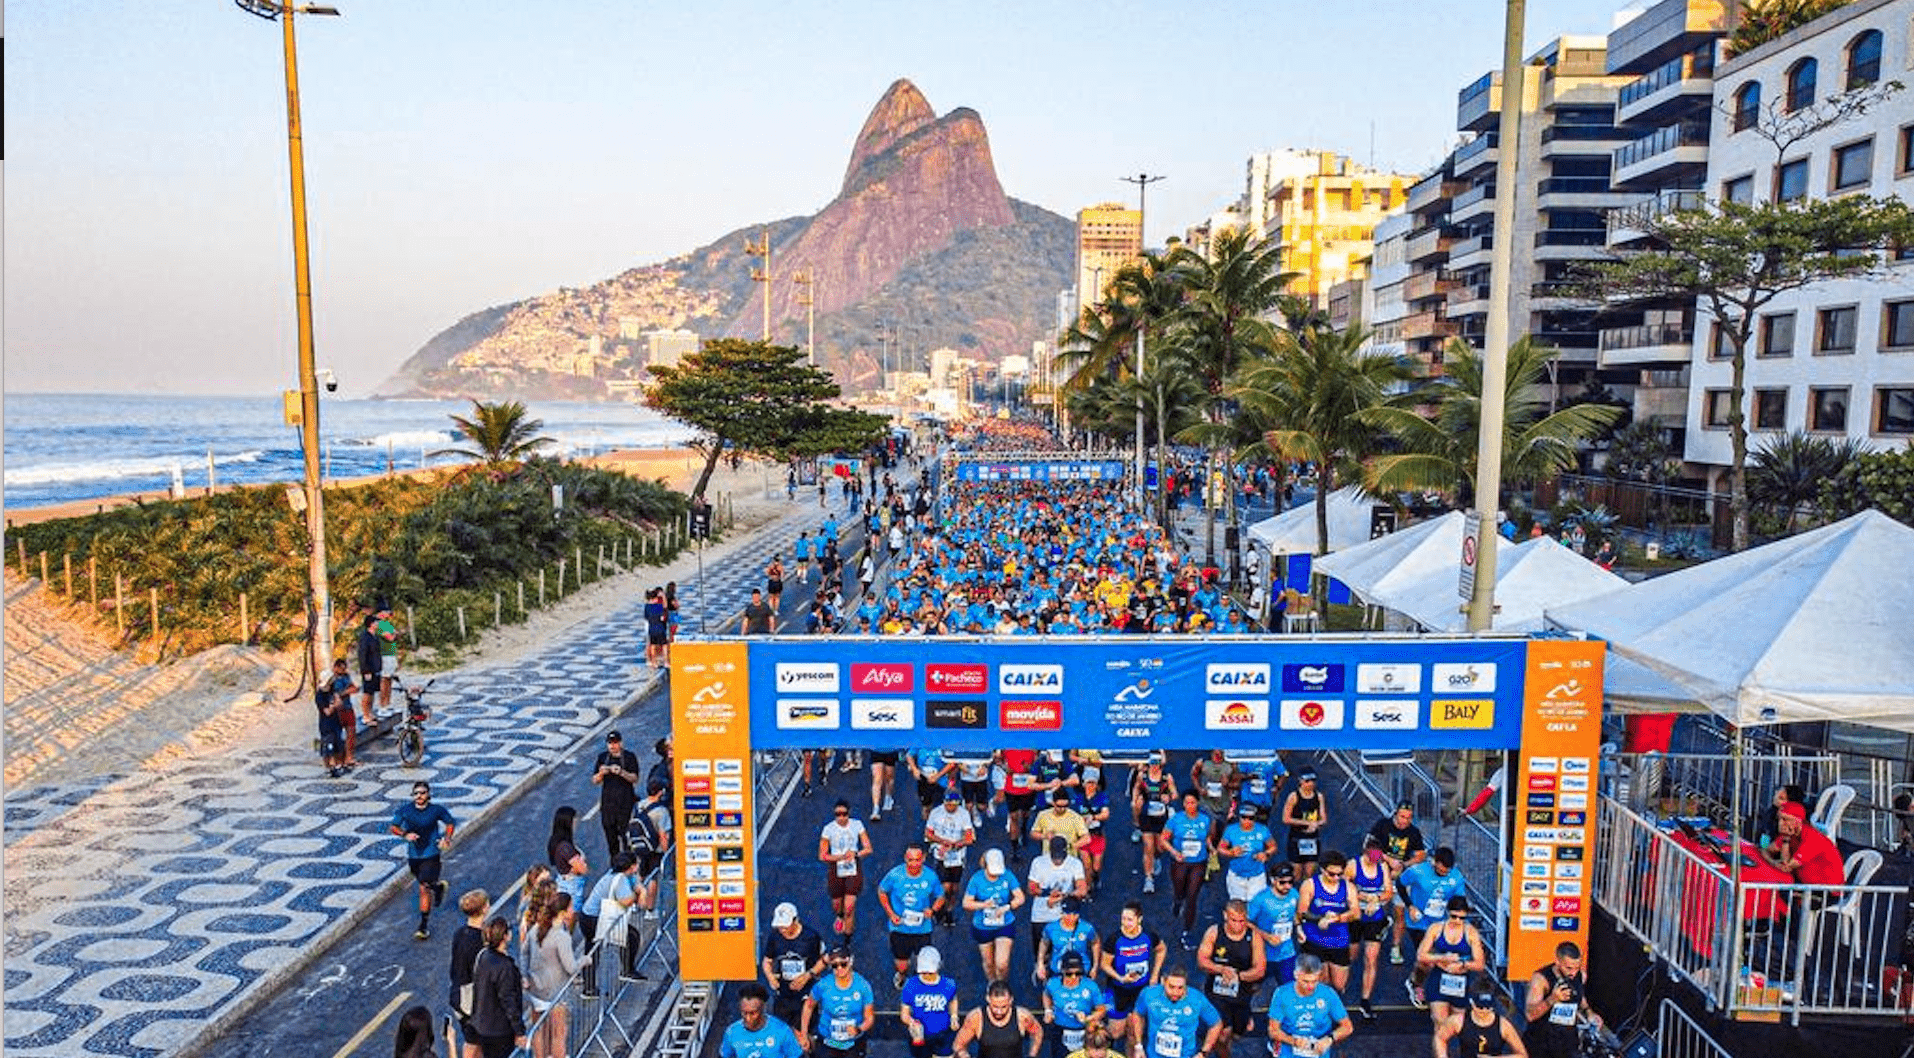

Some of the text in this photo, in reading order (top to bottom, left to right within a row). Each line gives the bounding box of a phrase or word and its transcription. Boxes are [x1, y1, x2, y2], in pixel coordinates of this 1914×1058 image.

[796, 671, 834, 681] yescom
[862, 667, 905, 688] Afya
[1004, 672, 1059, 686] CAIXA
[1210, 670, 1267, 686] CAIXA
[867, 710, 899, 723] Sesc
[1006, 705, 1056, 720] movida
[1371, 711, 1402, 723] Sesc
[1443, 703, 1480, 721] BALY
[1116, 727, 1151, 738] CAIXA
